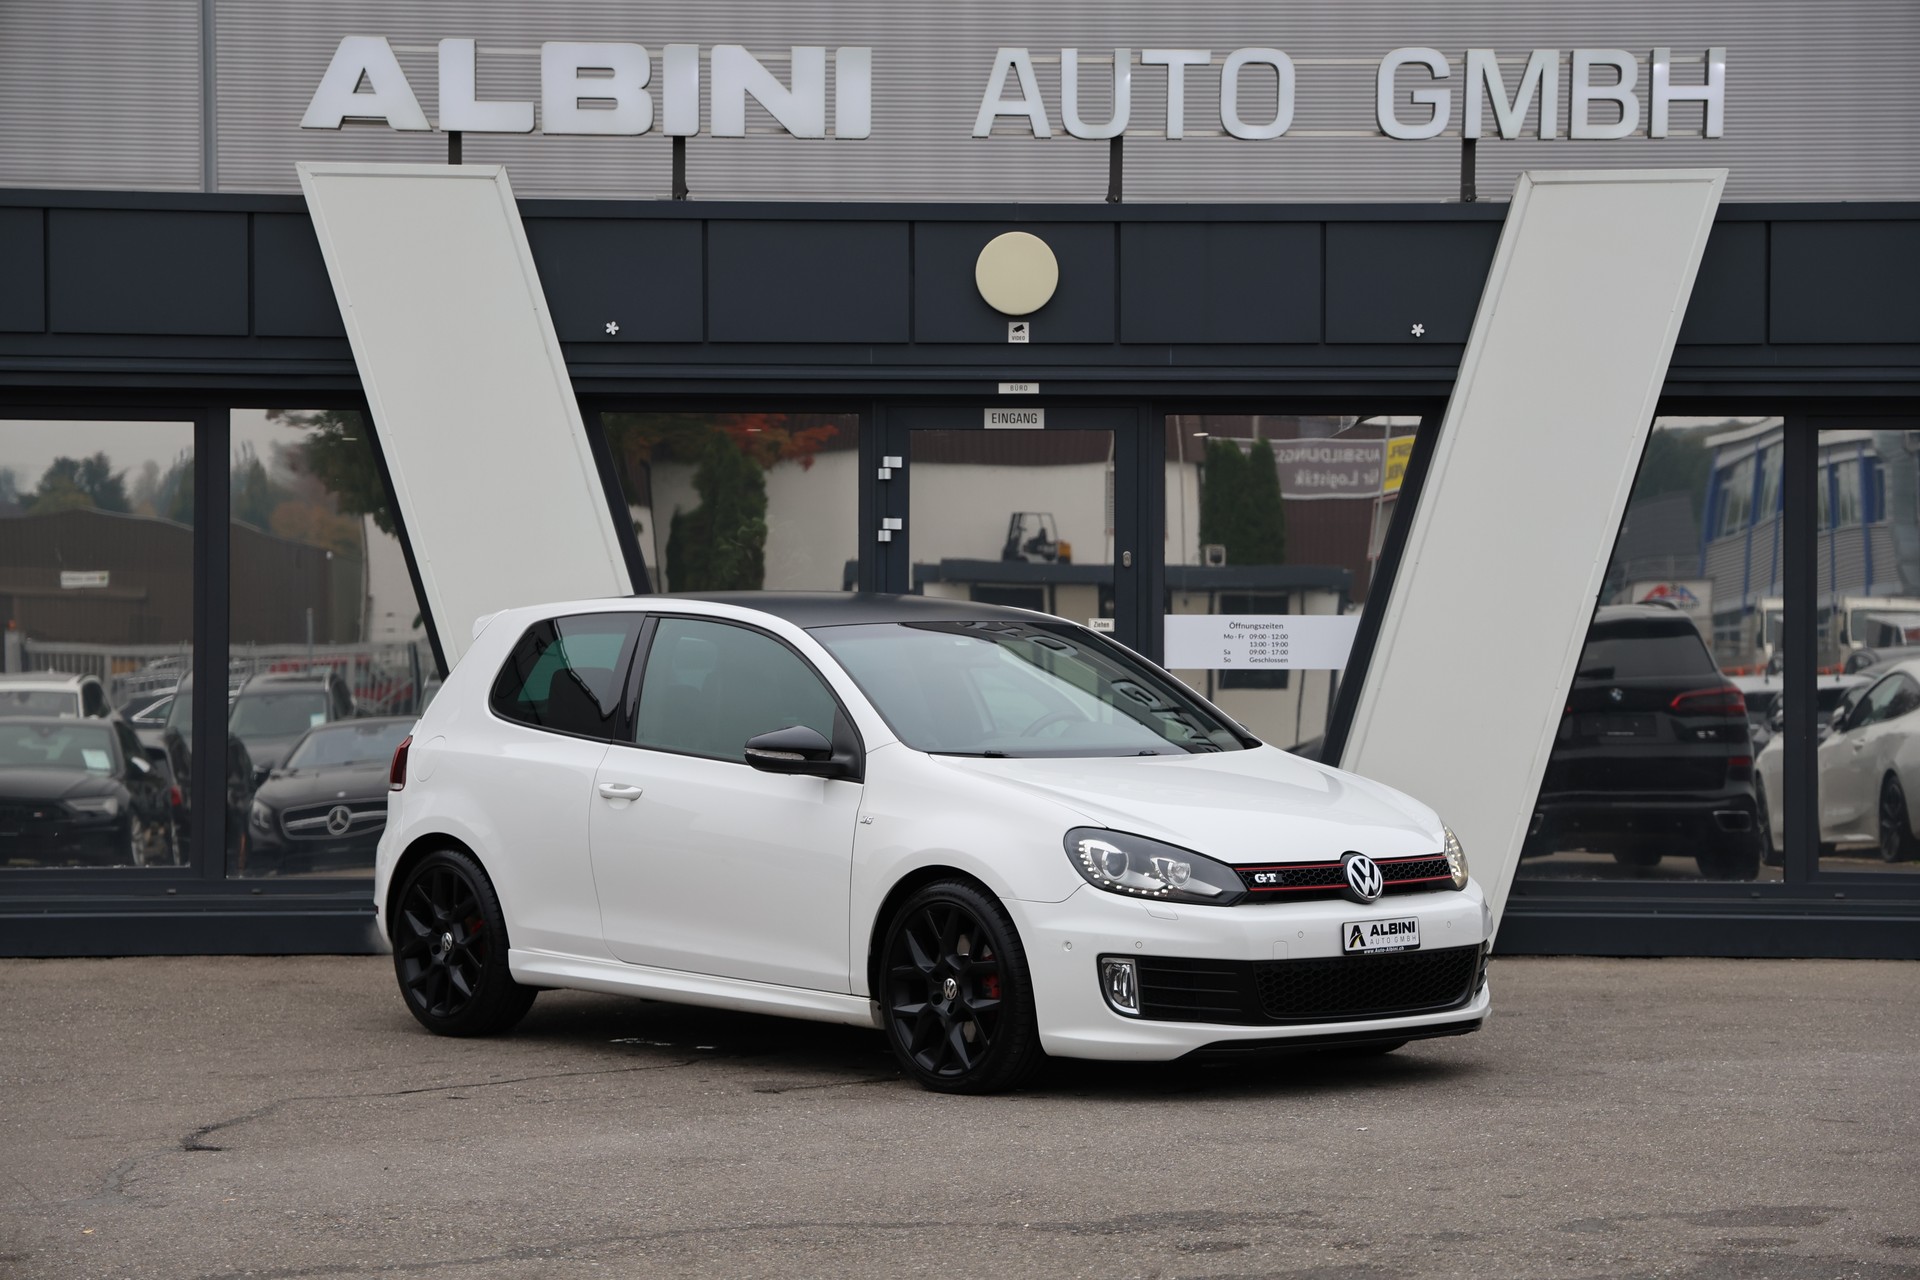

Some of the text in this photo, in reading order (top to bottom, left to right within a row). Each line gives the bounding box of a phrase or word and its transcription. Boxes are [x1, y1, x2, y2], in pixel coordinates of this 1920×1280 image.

[301, 35, 1727, 140] ALBINI AUTO GMBH
[1010, 384, 1028, 392] BÜRO
[991, 412, 1038, 425] EINGANG
[1093, 621, 1110, 629] Ziehen
[1229, 621, 1283, 630] Öffnungszeiten
[1369, 920, 1416, 937] ALBINI
[1369, 935, 1417, 945] AUTO GMBH
